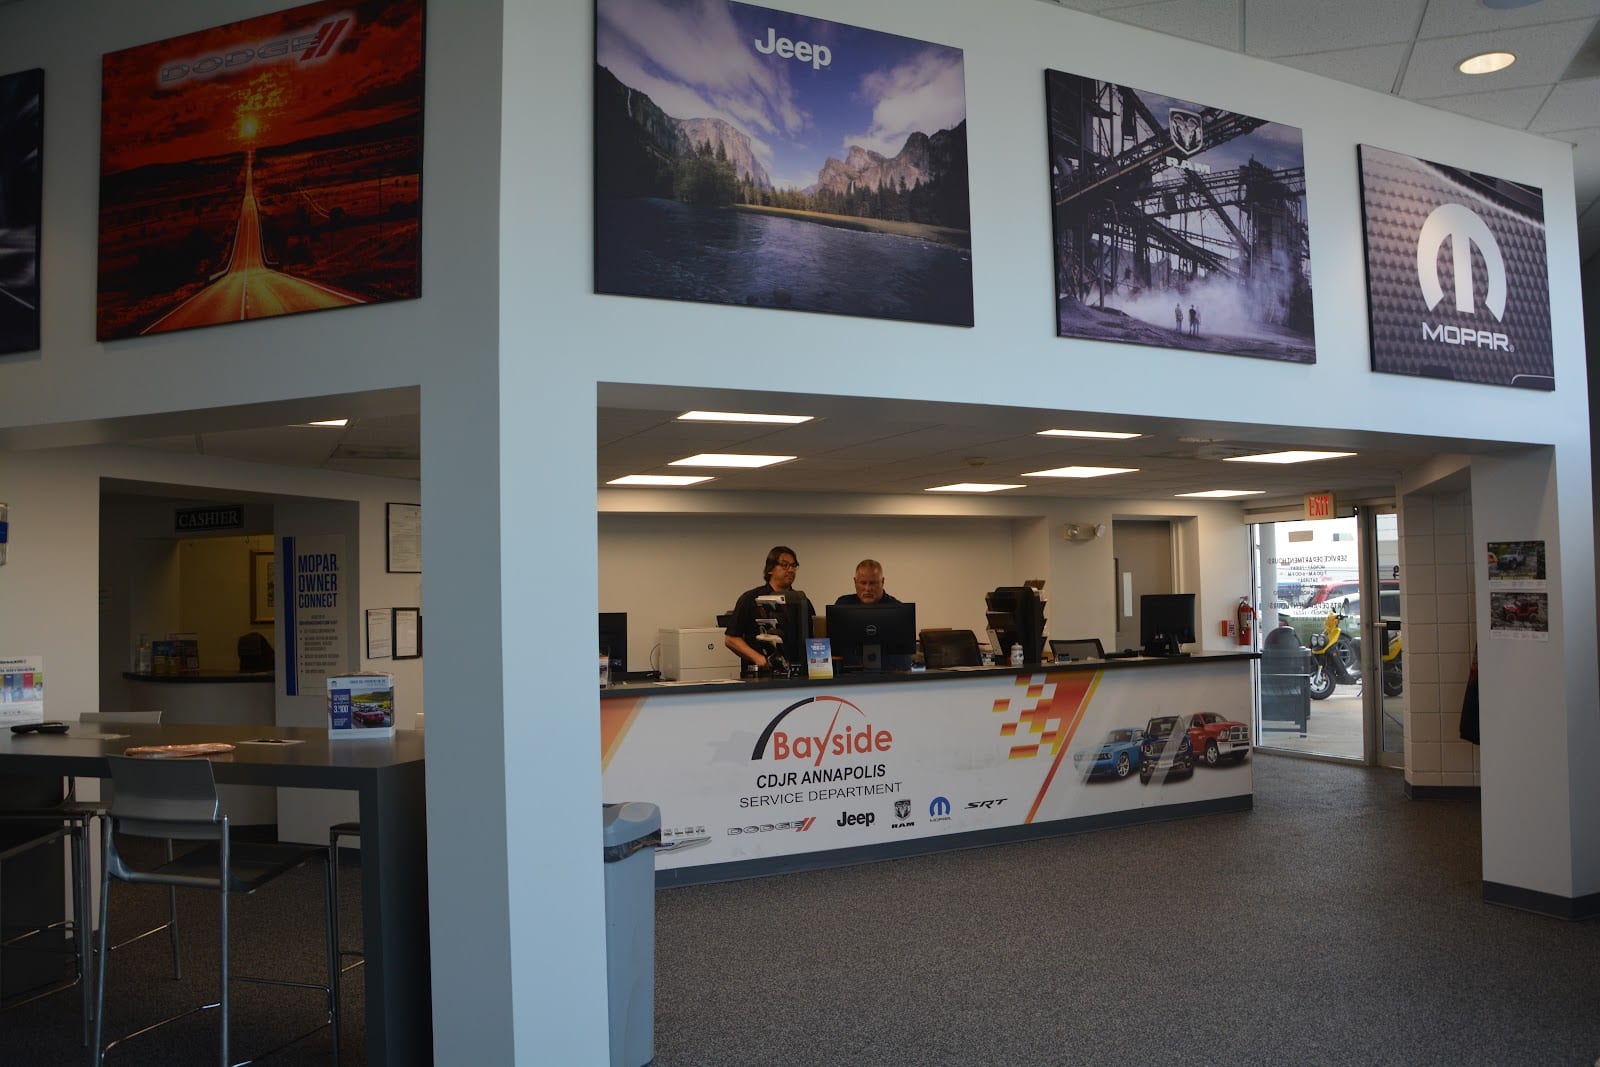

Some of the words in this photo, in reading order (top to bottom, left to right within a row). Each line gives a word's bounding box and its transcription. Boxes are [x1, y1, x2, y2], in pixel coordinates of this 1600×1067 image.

[160, 31, 320, 83] DODGE
[754, 27, 832, 70] Jeep
[1422, 321, 1510, 352] MOPAR
[1309, 495, 1330, 517] EXIT
[178, 511, 239, 527] CASHIER
[298, 553, 338, 573] MOPAR
[298, 573, 338, 593] OWNER
[298, 592, 339, 609] CONNECT
[774, 723, 893, 767] Bayside
[756, 772, 797, 789] CDJR
[801, 764, 886, 785] ANNAPOLIS
[739, 792, 804, 809] SERVICE
[808, 782, 903, 801] DEPARTMENT
[964, 798, 1008, 809] SRT
[727, 820, 805, 836] DODGE
[836, 811, 875, 828] Jeep
[891, 821, 915, 829] RAM
